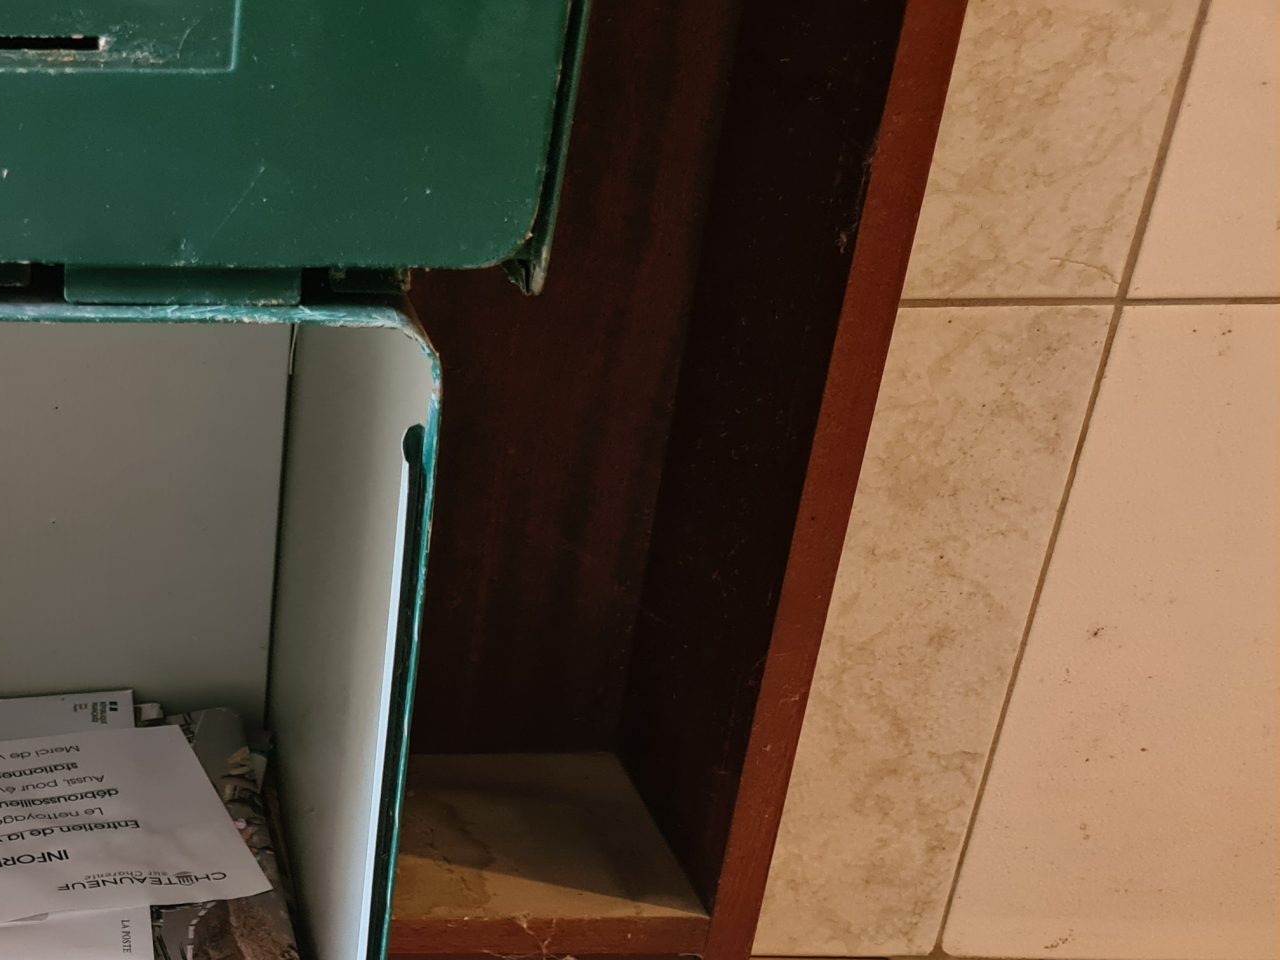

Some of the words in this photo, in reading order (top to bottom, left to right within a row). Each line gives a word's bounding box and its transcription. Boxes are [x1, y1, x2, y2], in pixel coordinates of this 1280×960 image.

[9, 750, 32, 760] de
[35, 744, 80, 757] Merci
[19, 778, 58, 793] pour
[62, 773, 105, 788] Aussi,
[83, 806, 104, 816] Le
[29, 826, 55, 838] de
[60, 819, 141, 834] Entretien
[7, 830, 25, 842] la
[83, 869, 142, 881] Charente
[154, 870, 168, 878] sur
[120, 919, 130, 930] LA
[122, 931, 132, 953] POSTE
